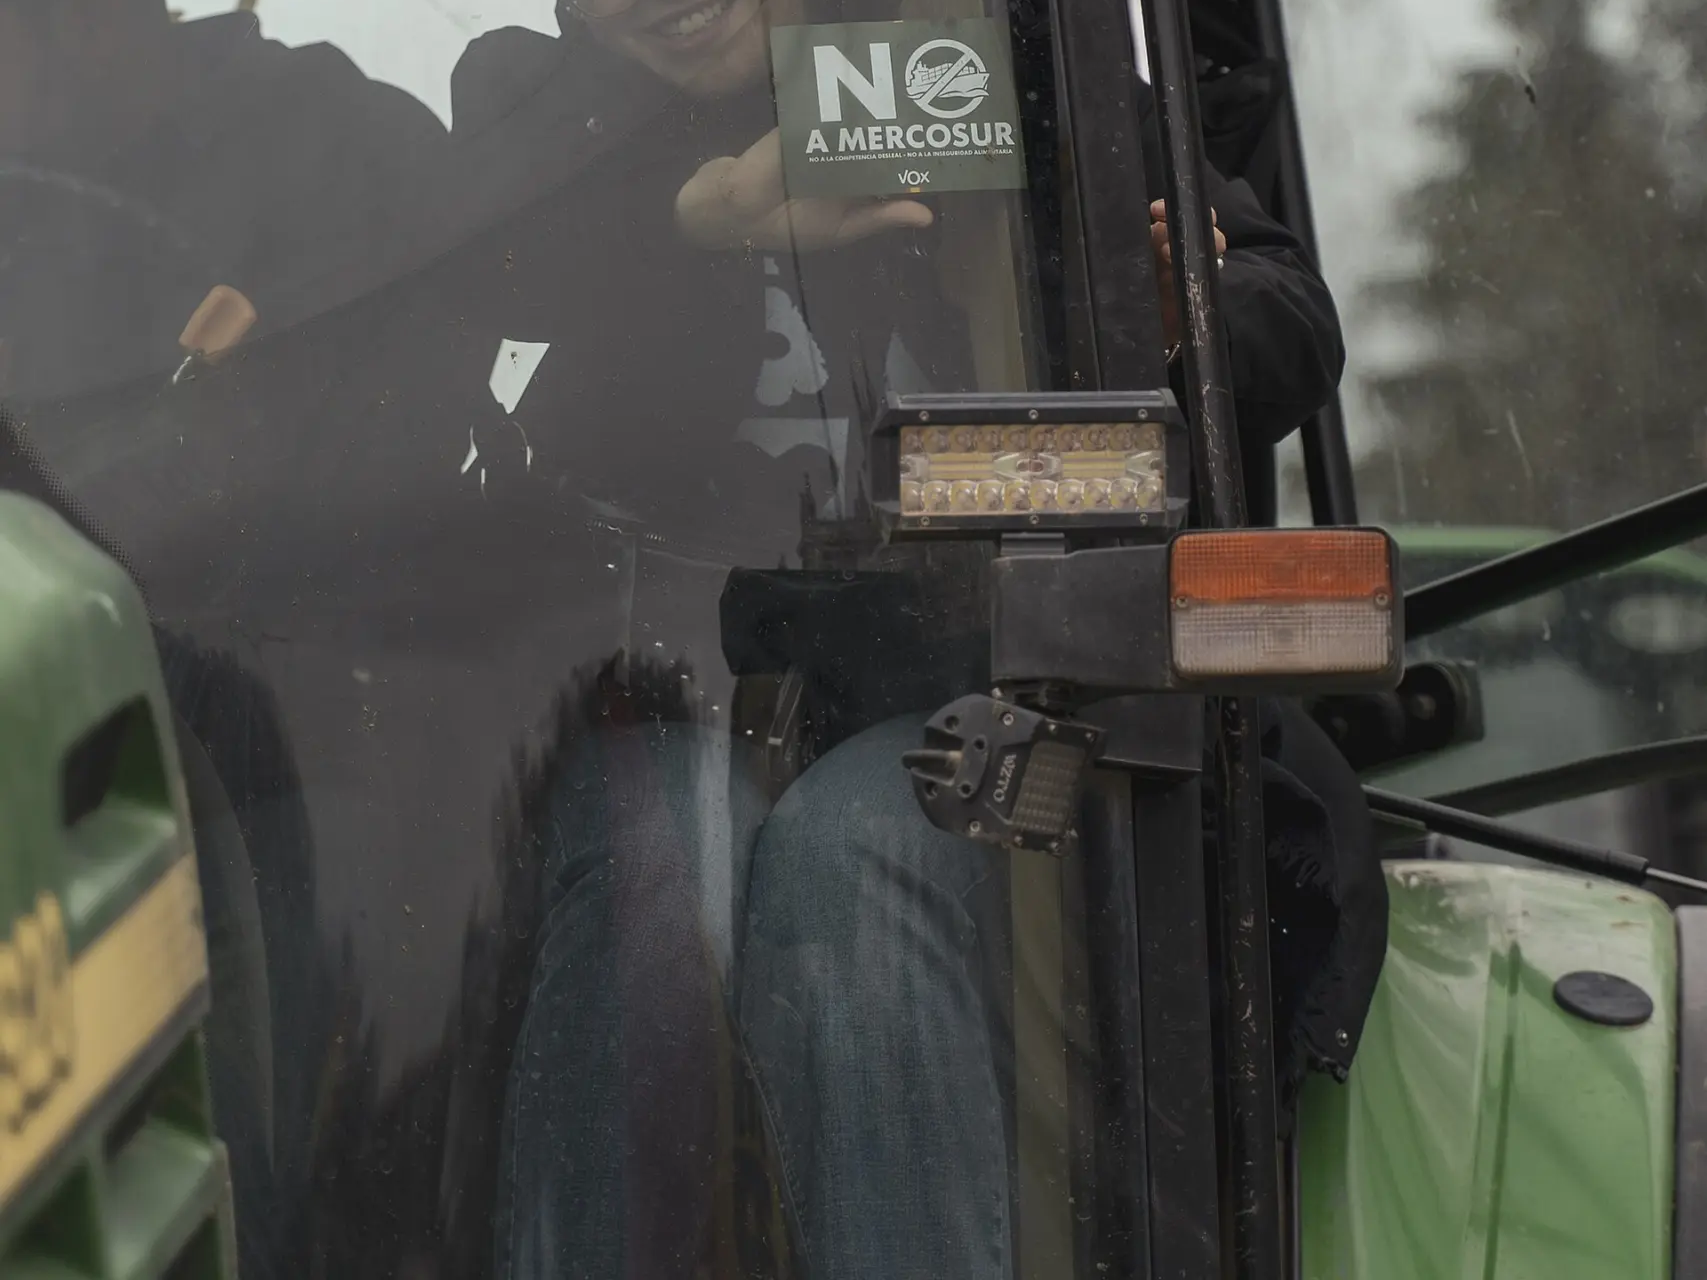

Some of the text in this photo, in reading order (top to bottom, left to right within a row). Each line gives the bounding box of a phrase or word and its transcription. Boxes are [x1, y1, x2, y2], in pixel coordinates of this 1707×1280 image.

[806, 122, 1015, 154] A MERCOSUR
[835, 153, 877, 161] COMPETENCIA
[933, 149, 973, 157] INSEGURIDAD
[897, 169, 930, 185] VOX
